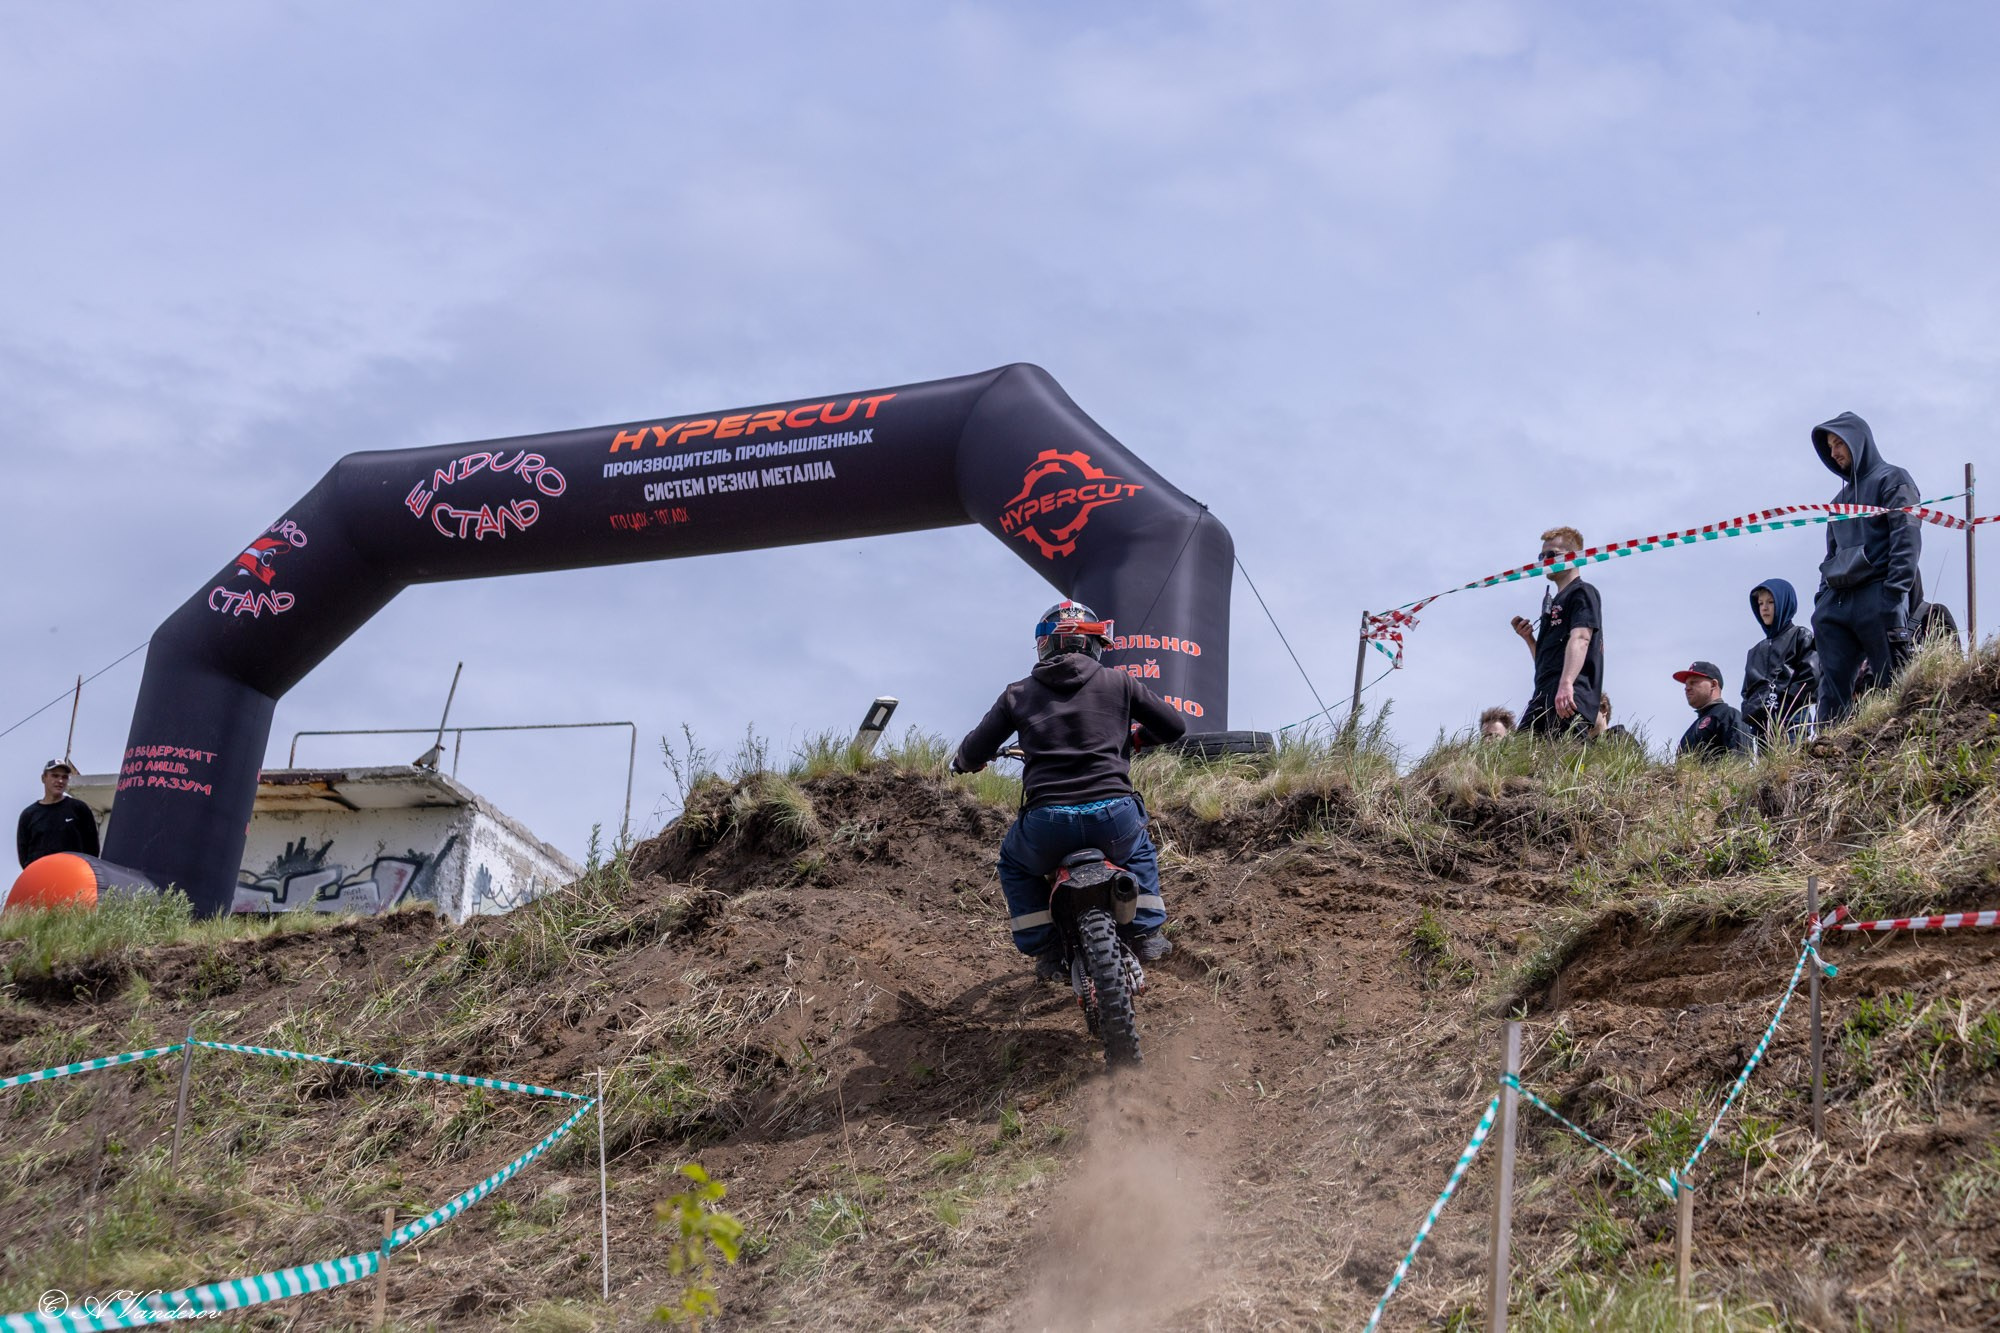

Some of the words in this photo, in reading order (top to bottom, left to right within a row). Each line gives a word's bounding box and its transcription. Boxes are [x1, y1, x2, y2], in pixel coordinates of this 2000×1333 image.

[609, 393, 897, 453] HYPERCUT
[603, 448, 732, 478] ПРОИЗВОДИТЕЛЬ
[735, 428, 874, 461] ПРОМЫШЛЕННЫХ
[405, 450, 566, 518] ENDURO
[643, 477, 705, 502] СИСТЕМ
[707, 470, 759, 494] РЕЗКИ
[761, 460, 836, 487] МЕТАЛЛА
[431, 499, 540, 540] СТАЛЬ
[999, 483, 1145, 534] HYPERCUT
[270, 518, 308, 547] URO
[208, 585, 295, 618] СТАЛЬ
[1103, 633, 1202, 657] ально
[134, 745, 218, 763] ВЫДЕРЖИТ
[144, 760, 189, 775] ЛИШЬ
[147, 775, 213, 796] РАЗУМ
